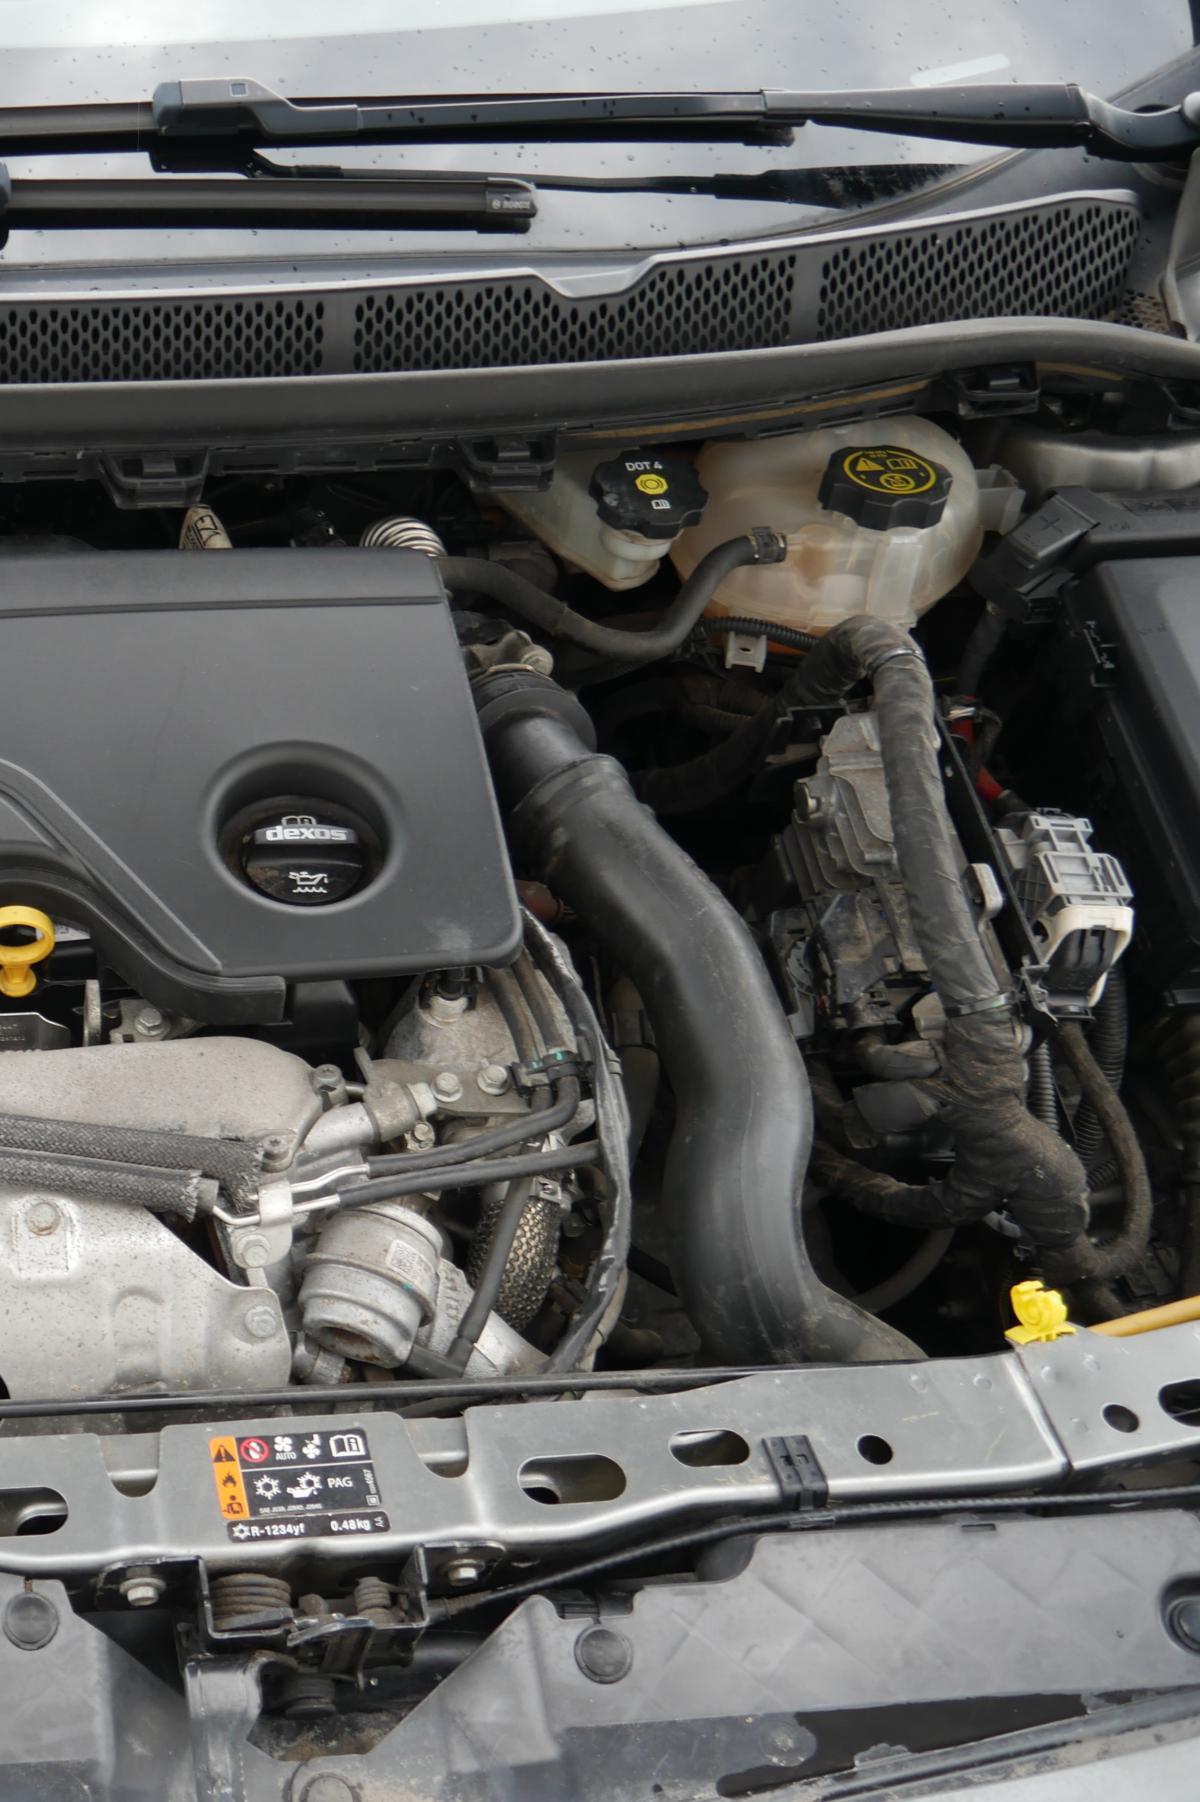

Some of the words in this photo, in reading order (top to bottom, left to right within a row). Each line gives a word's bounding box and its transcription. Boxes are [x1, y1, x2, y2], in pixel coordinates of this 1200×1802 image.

[625, 462, 650, 471] DOT
[653, 461, 663, 470] 4
[266, 826, 347, 841] dexos
[275, 1451, 297, 1461] AUTO
[327, 1476, 353, 1488] PAG
[250, 1523, 305, 1537] R-1234yf
